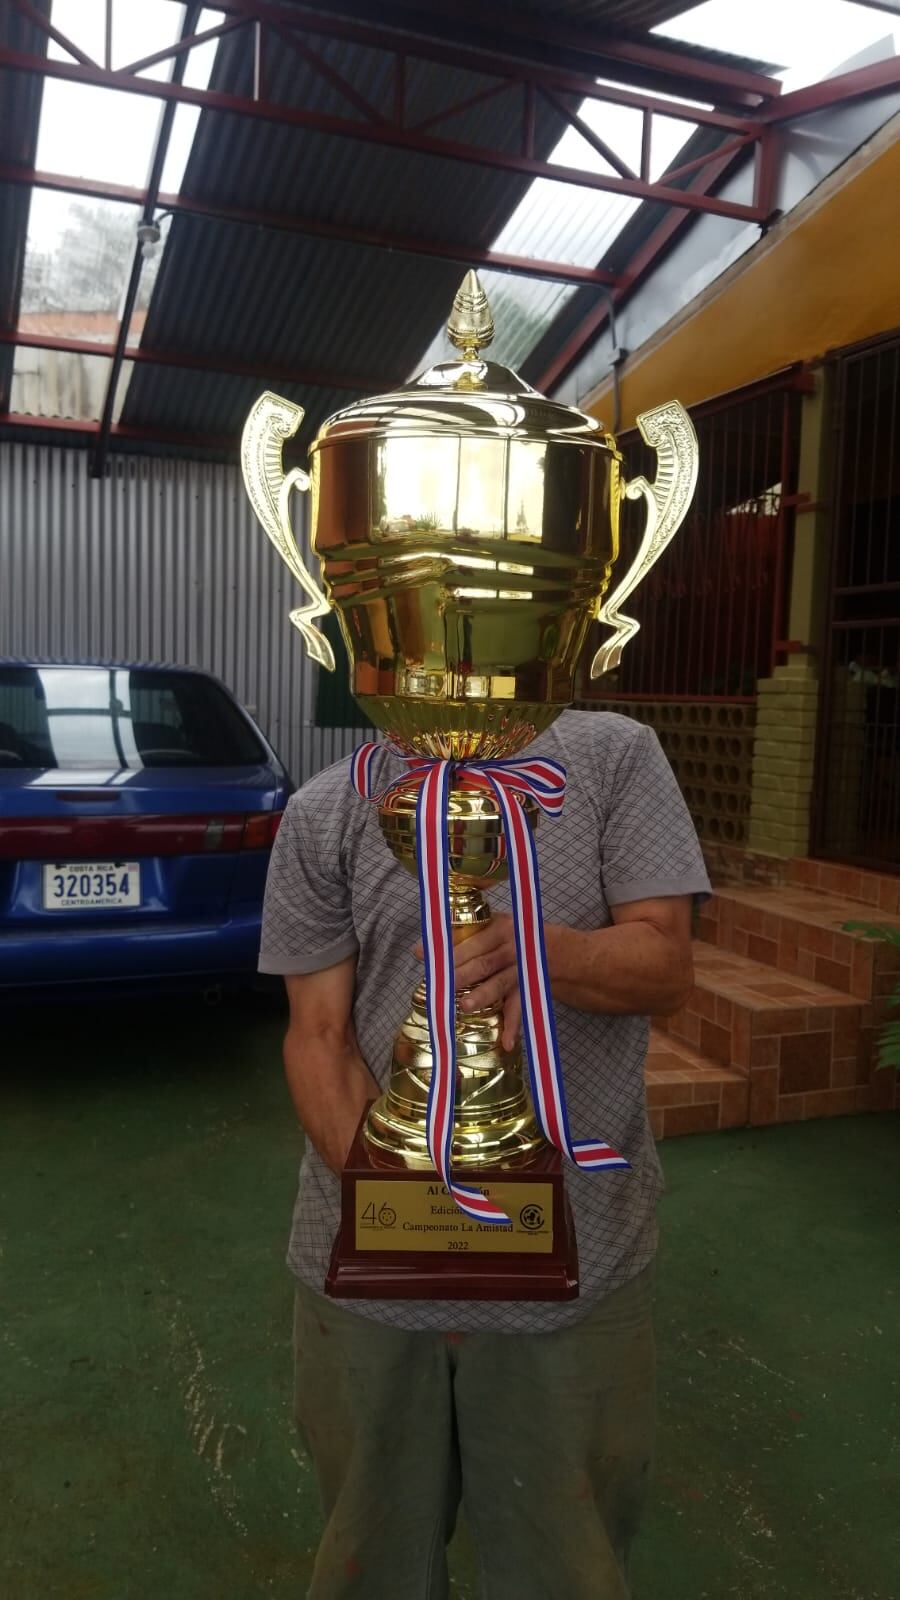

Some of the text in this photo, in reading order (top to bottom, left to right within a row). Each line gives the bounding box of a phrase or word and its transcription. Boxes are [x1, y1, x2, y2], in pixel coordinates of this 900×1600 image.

[53, 873, 130, 898] 320354
[61, 898, 123, 906] CENTROAMERICA
[427, 1186, 439, 1195] Al
[361, 1201, 397, 1227] 46
[431, 1205, 464, 1216] Edició
[402, 1222, 459, 1232] Campeonato
[461, 1222, 473, 1232] La
[476, 1222, 514, 1232] Amistad
[447, 1241, 469, 1250] 2022
